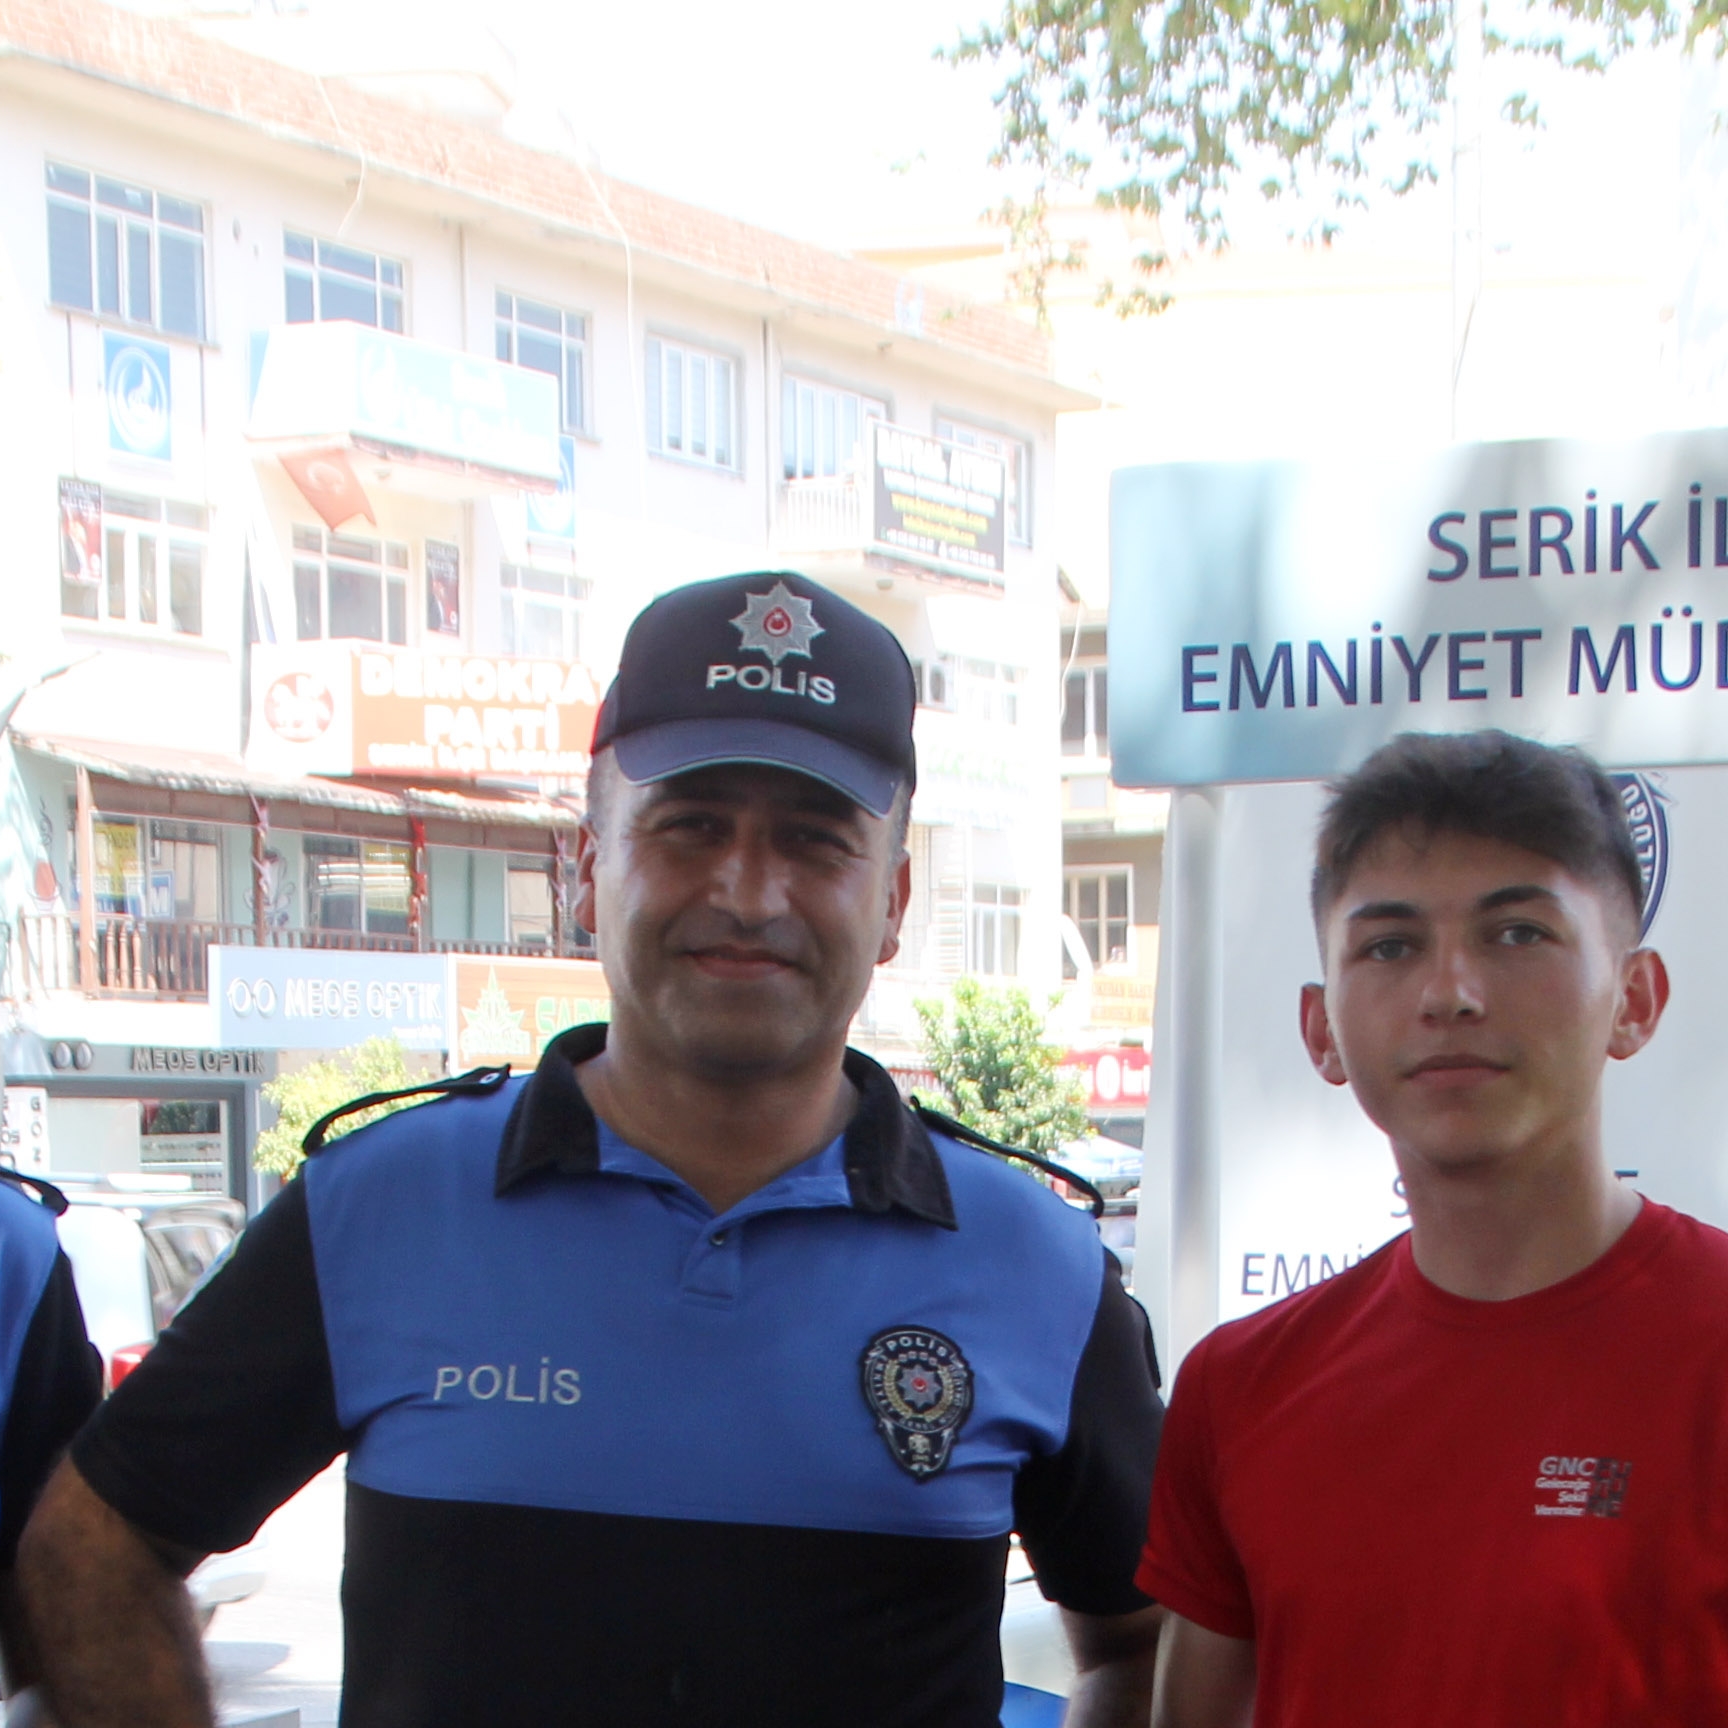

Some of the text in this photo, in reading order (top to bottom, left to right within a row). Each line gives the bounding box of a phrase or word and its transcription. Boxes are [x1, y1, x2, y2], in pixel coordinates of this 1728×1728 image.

[1426, 490, 1663, 584] SERİK
[360, 651, 600, 705] DEMOKRA
[1179, 621, 1543, 714] EMNİYET
[433, 1356, 582, 1405] POLİS
